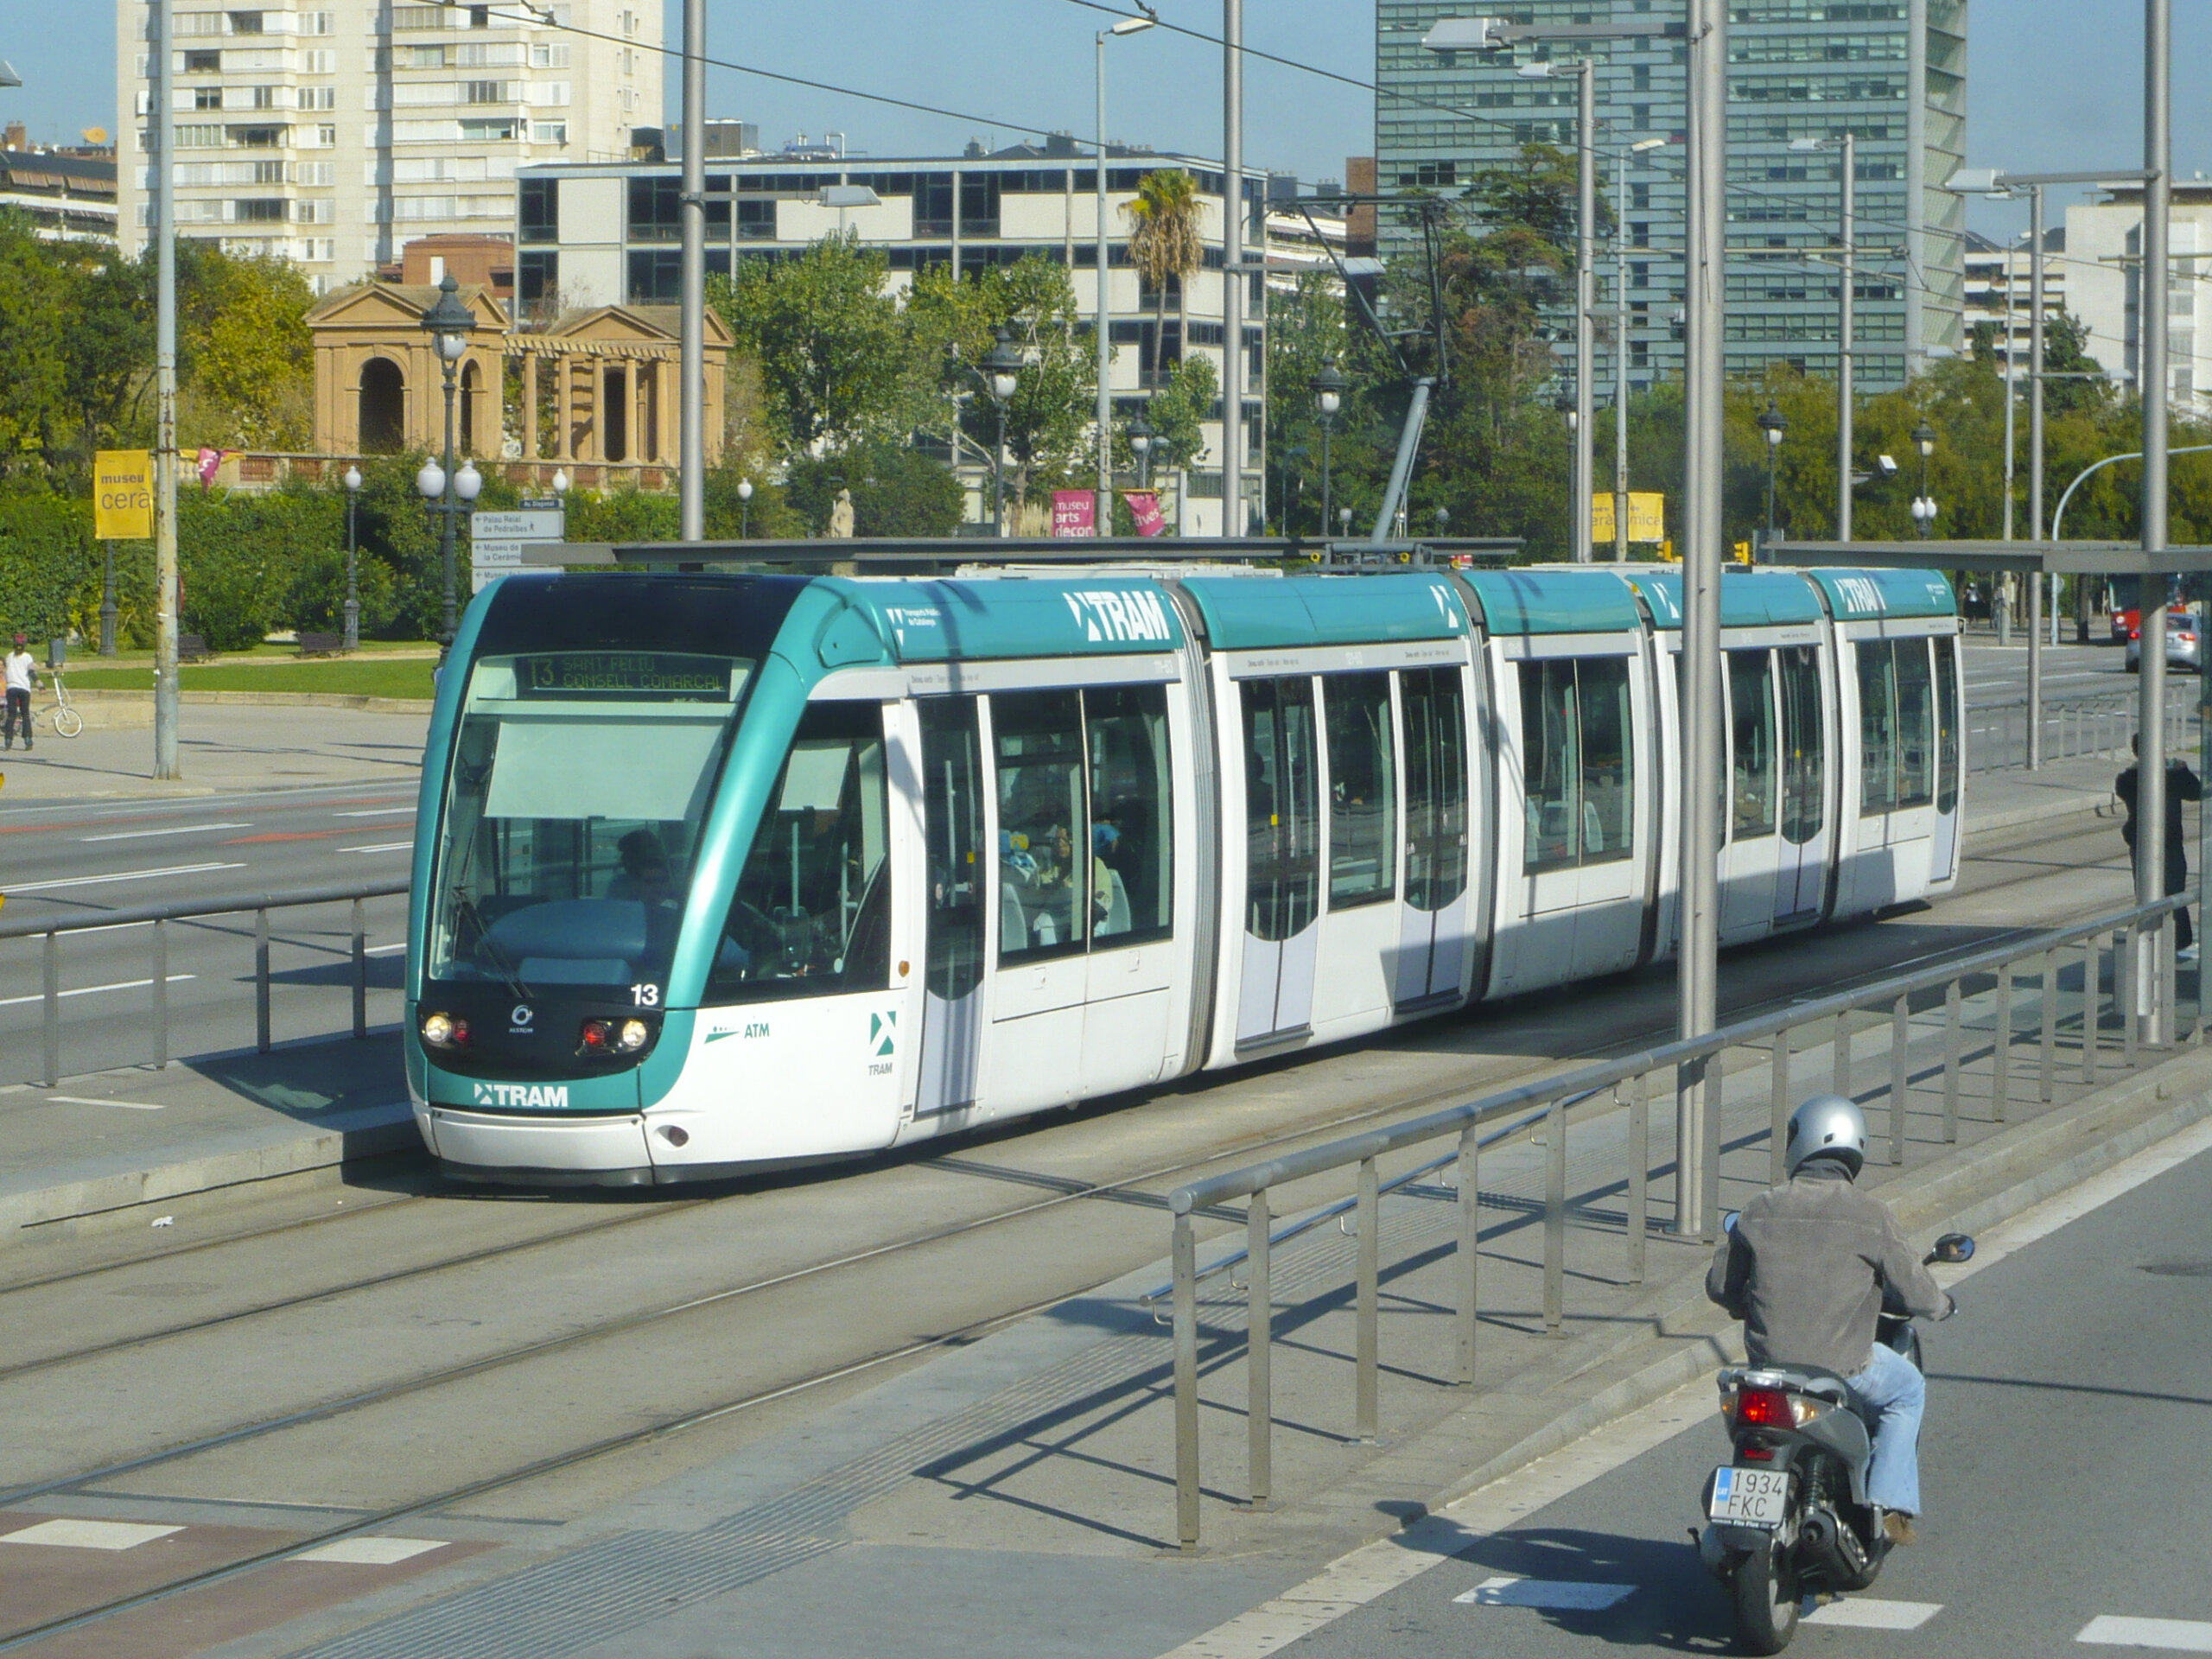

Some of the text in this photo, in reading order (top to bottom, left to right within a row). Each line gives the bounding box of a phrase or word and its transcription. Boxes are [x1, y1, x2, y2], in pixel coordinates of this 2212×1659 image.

[100, 474, 145, 484] museu
[101, 487, 150, 510] cerà
[1056, 501, 1089, 511] museu
[1055, 512, 1080, 524] arts
[1629, 513, 1662, 526] mica
[484, 524, 493, 533] de
[1055, 524, 1092, 537] decor
[1083, 591, 1171, 641] TRAM
[527, 657, 656, 688] T3 SANT FELIU
[563, 674, 724, 690] CONSELL COMARCAL
[631, 983, 658, 1006] 13
[744, 1023, 770, 1039] ATM
[868, 1062, 893, 1077] TRAM
[493, 1084, 569, 1108] TRAM
[1735, 1471, 1783, 1497] 1934
[1727, 1495, 1767, 1517] FKC
